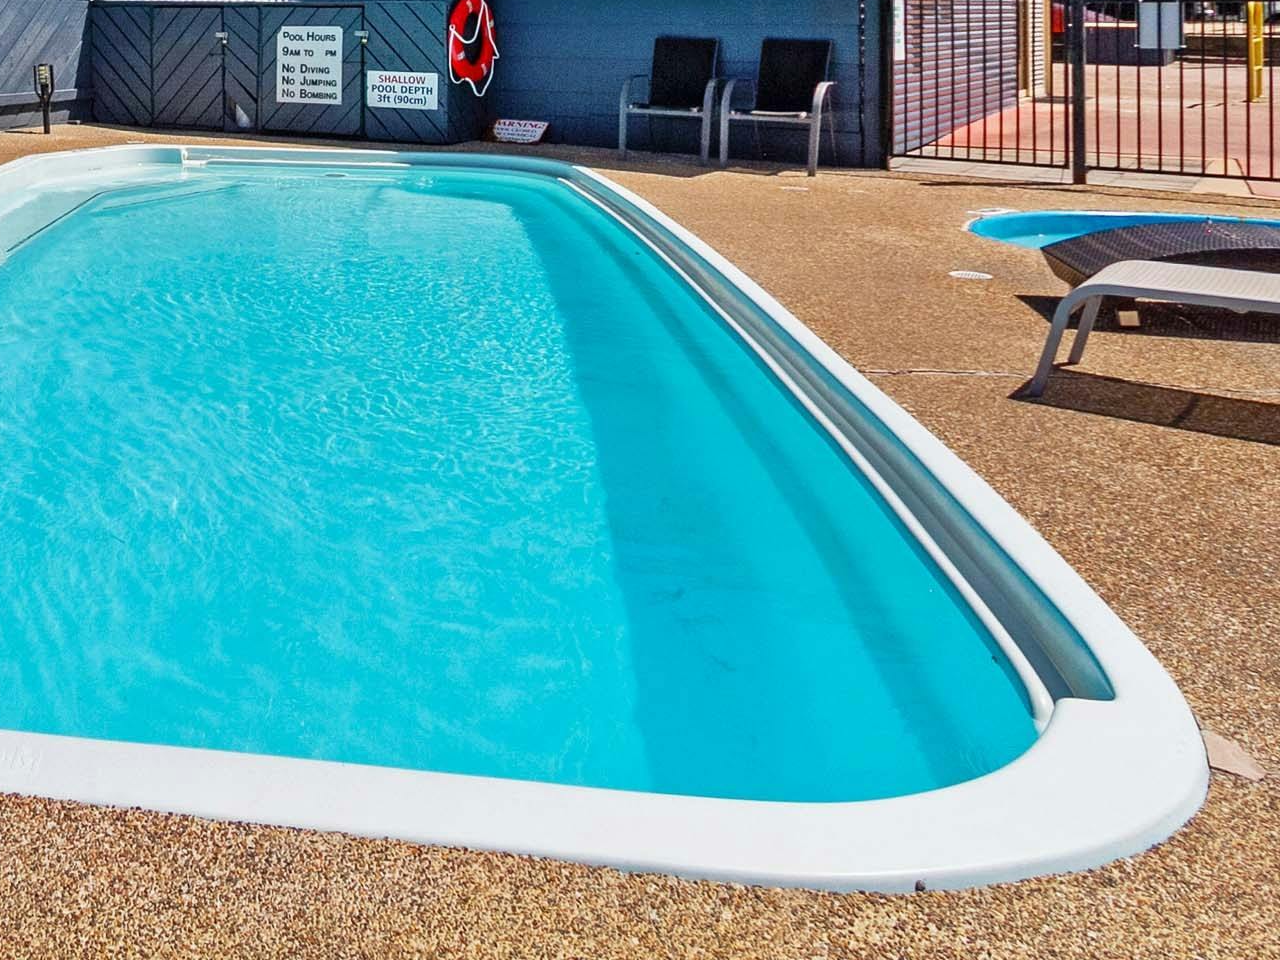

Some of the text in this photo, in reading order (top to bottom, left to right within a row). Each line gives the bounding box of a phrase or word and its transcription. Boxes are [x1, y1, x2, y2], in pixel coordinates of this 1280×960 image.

[378, 74, 426, 85] SHALLOW
[371, 84, 433, 96] POOL DEPTH
[376, 93, 427, 106] 3ft (90cm)
